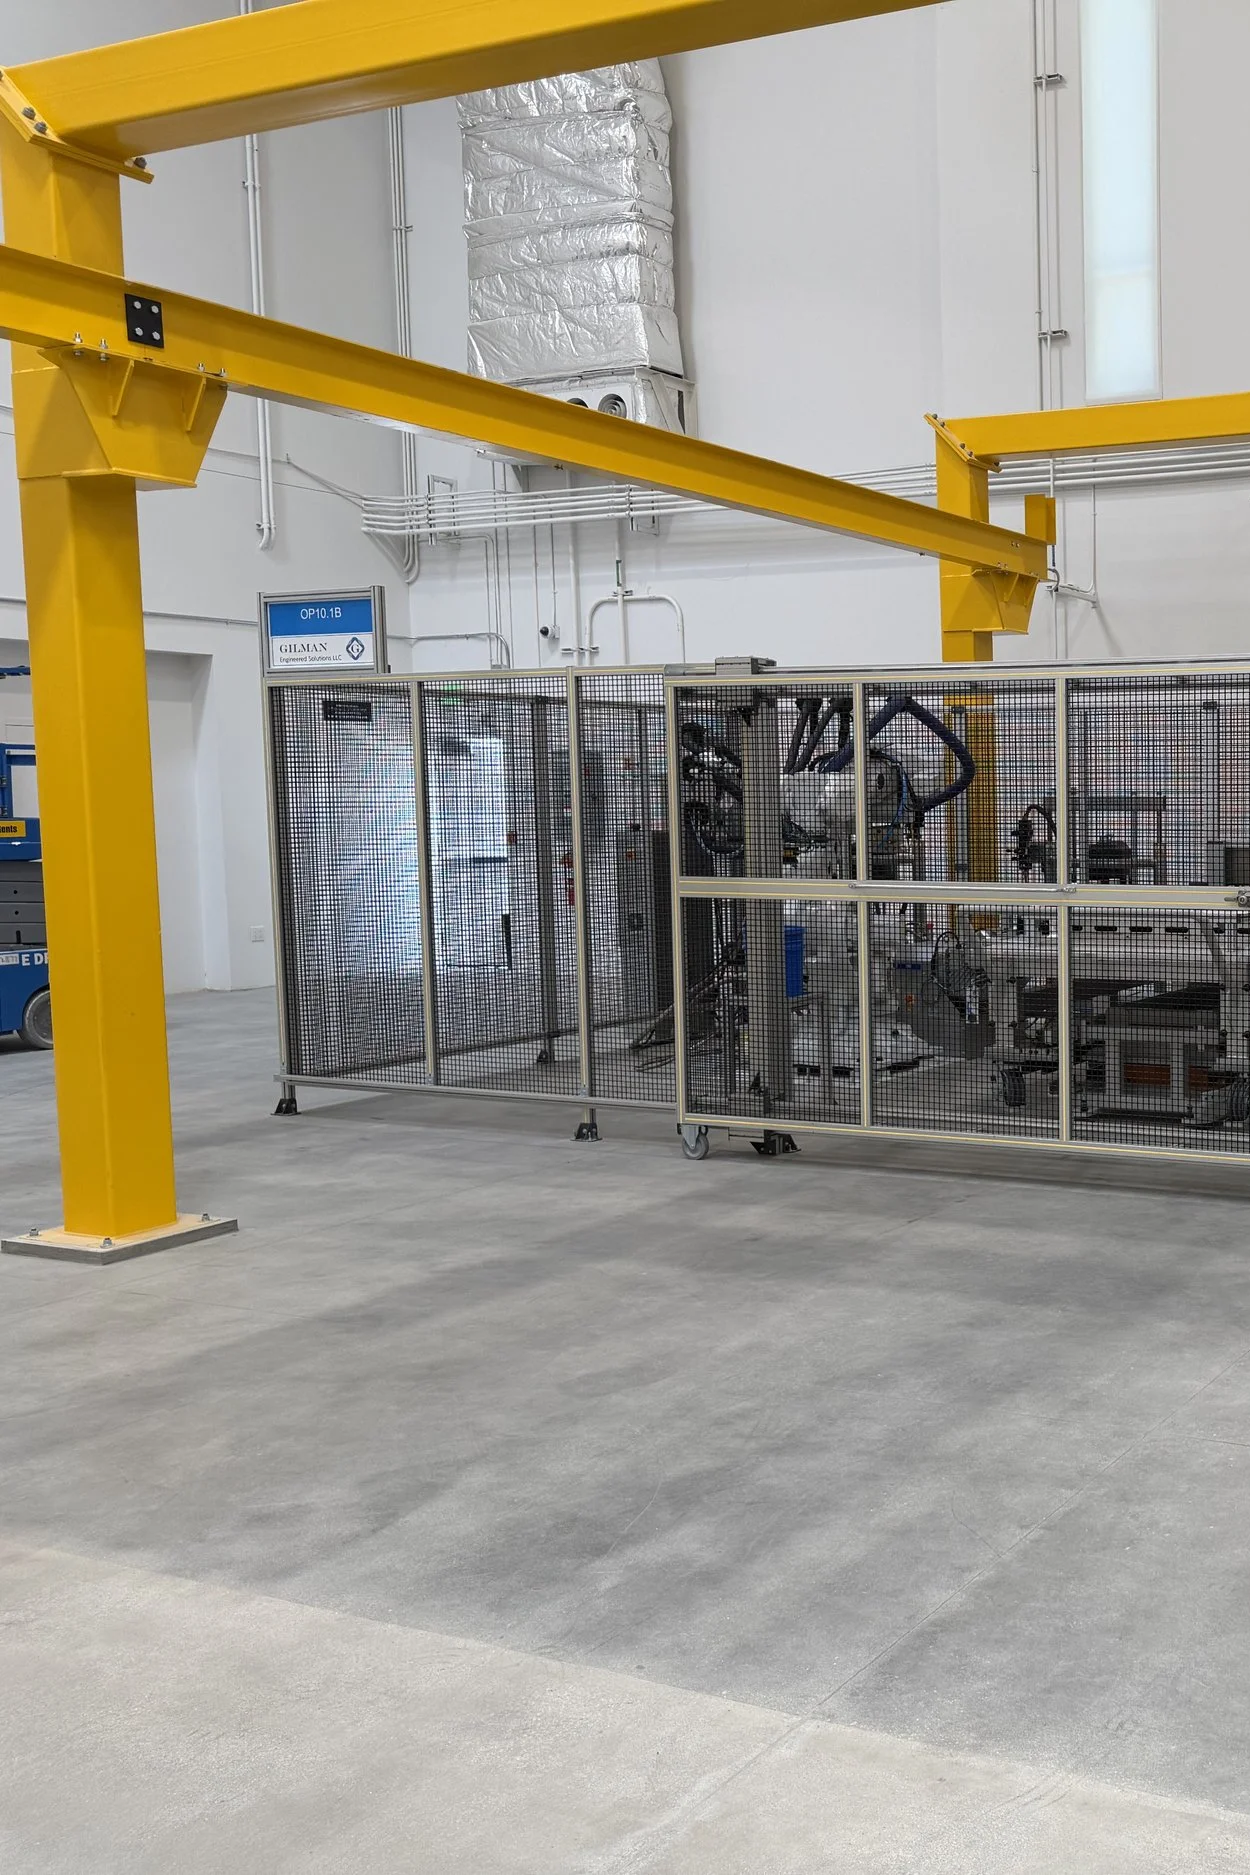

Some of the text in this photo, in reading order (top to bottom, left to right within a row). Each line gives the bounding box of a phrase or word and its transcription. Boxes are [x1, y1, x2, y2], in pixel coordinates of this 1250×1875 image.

[300, 606, 342, 620] OP10.1B
[279, 642, 328, 653] GILMAN
[0, 825, 18, 833] ents
[21, 954, 31, 966] E
